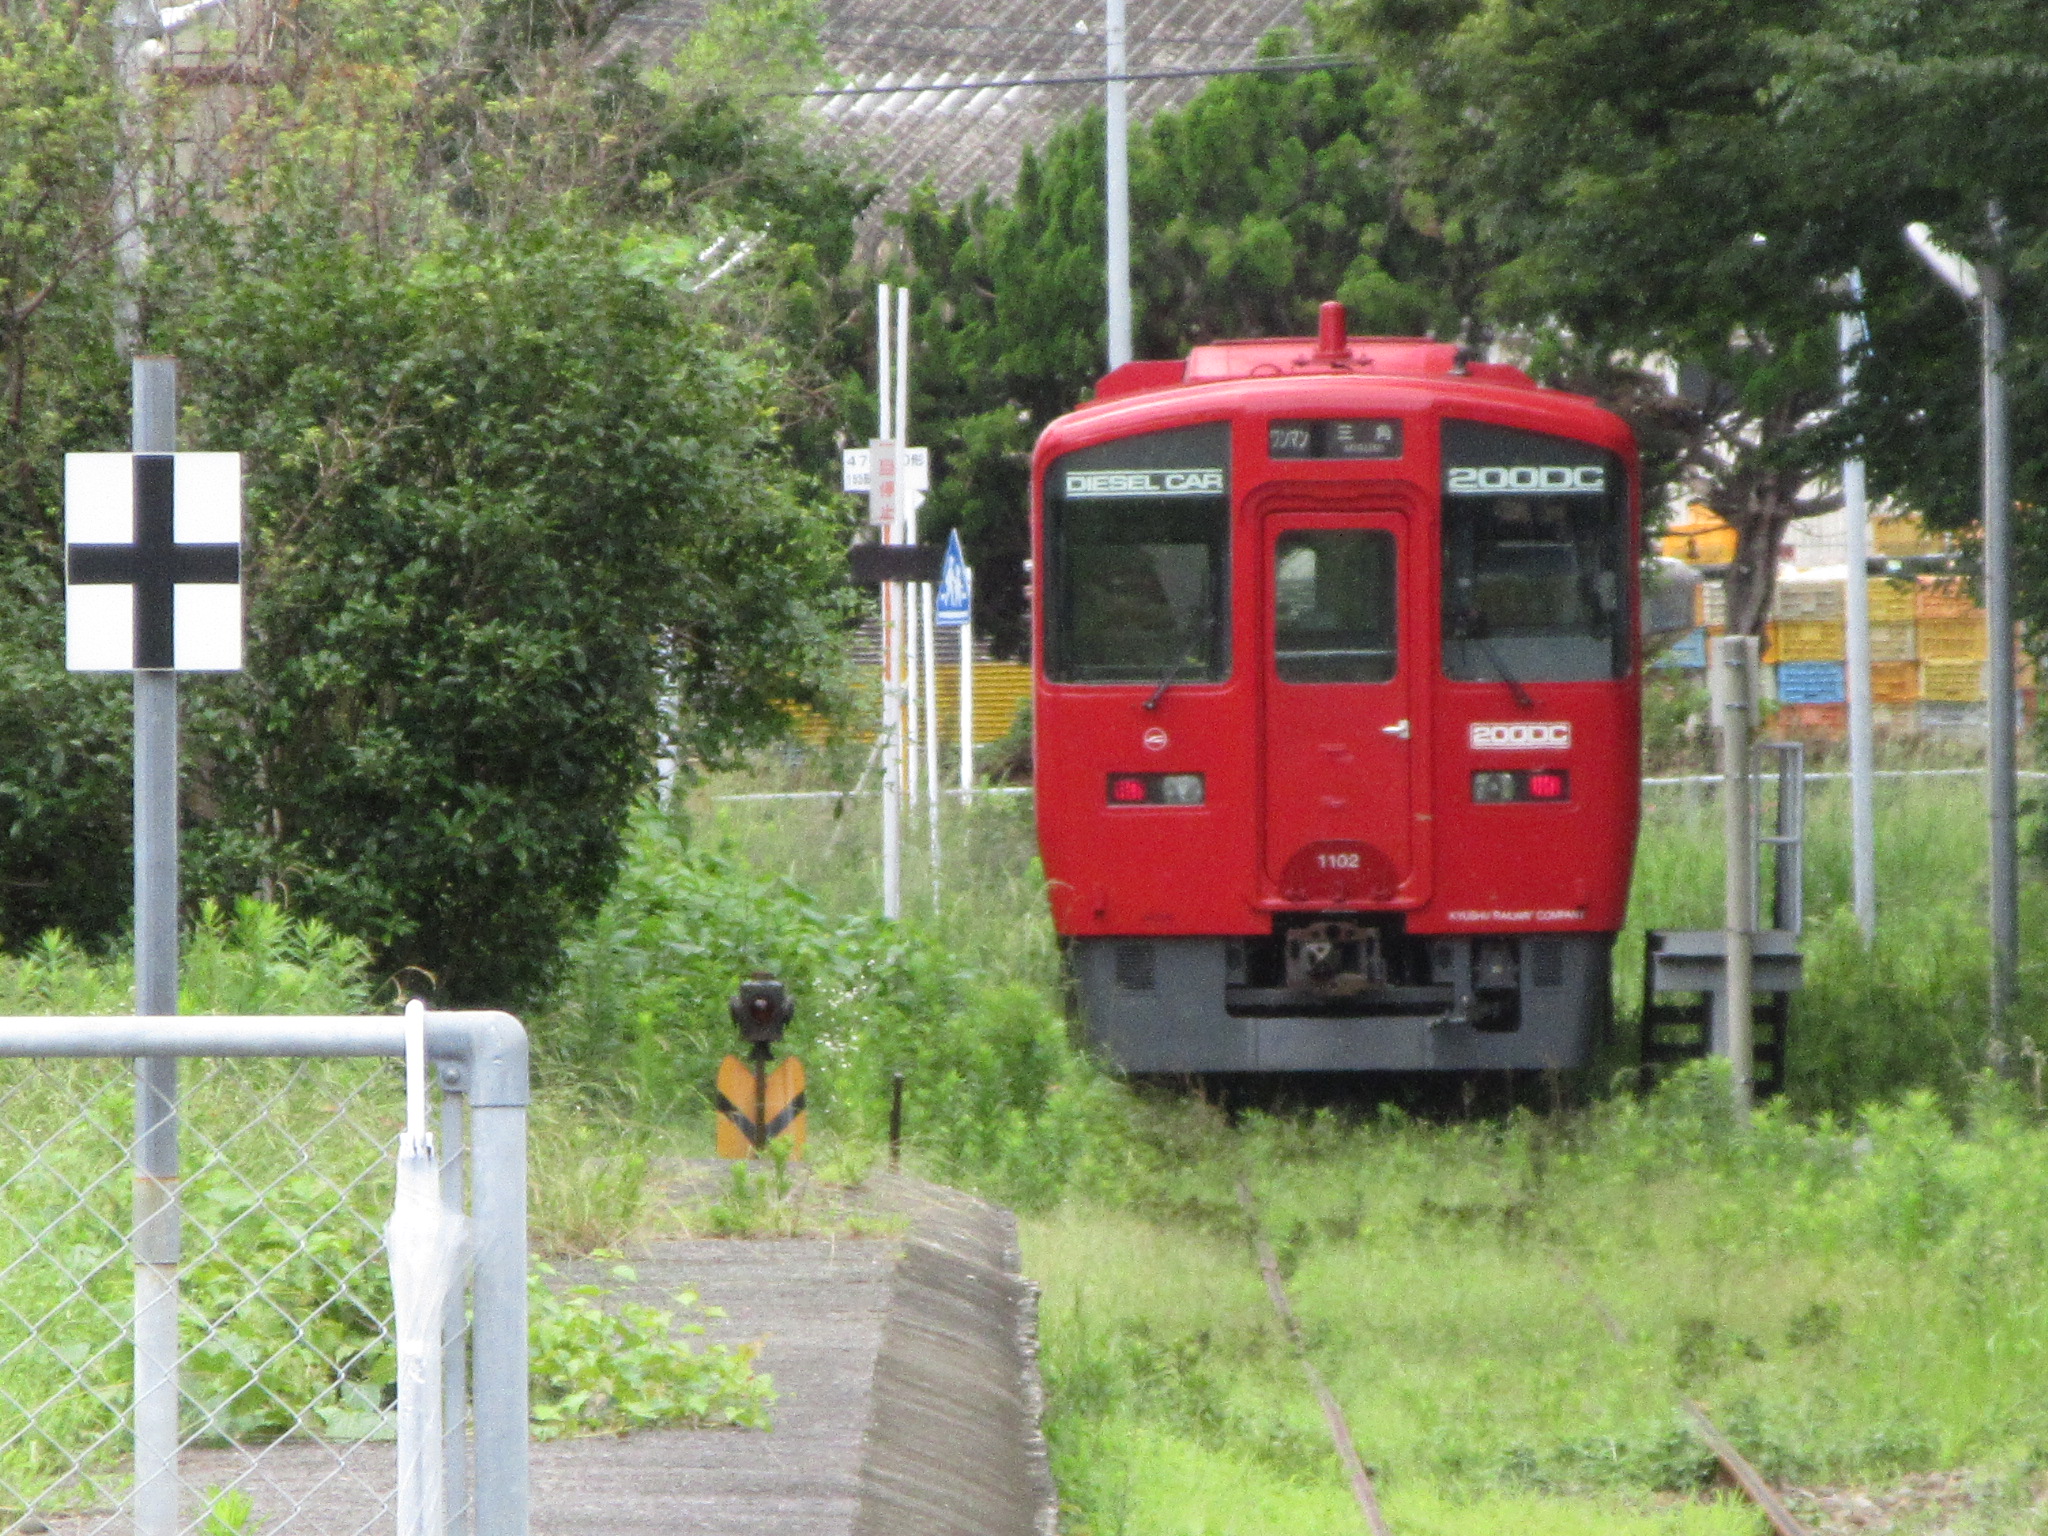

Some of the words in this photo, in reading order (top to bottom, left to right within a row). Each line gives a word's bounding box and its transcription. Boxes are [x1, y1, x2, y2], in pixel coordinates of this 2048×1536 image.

[1066, 473, 1160, 493] DIESEL
[1165, 472, 1223, 491] CAR
[1448, 466, 1604, 490] 200DC
[1316, 853, 1360, 868] 1102
